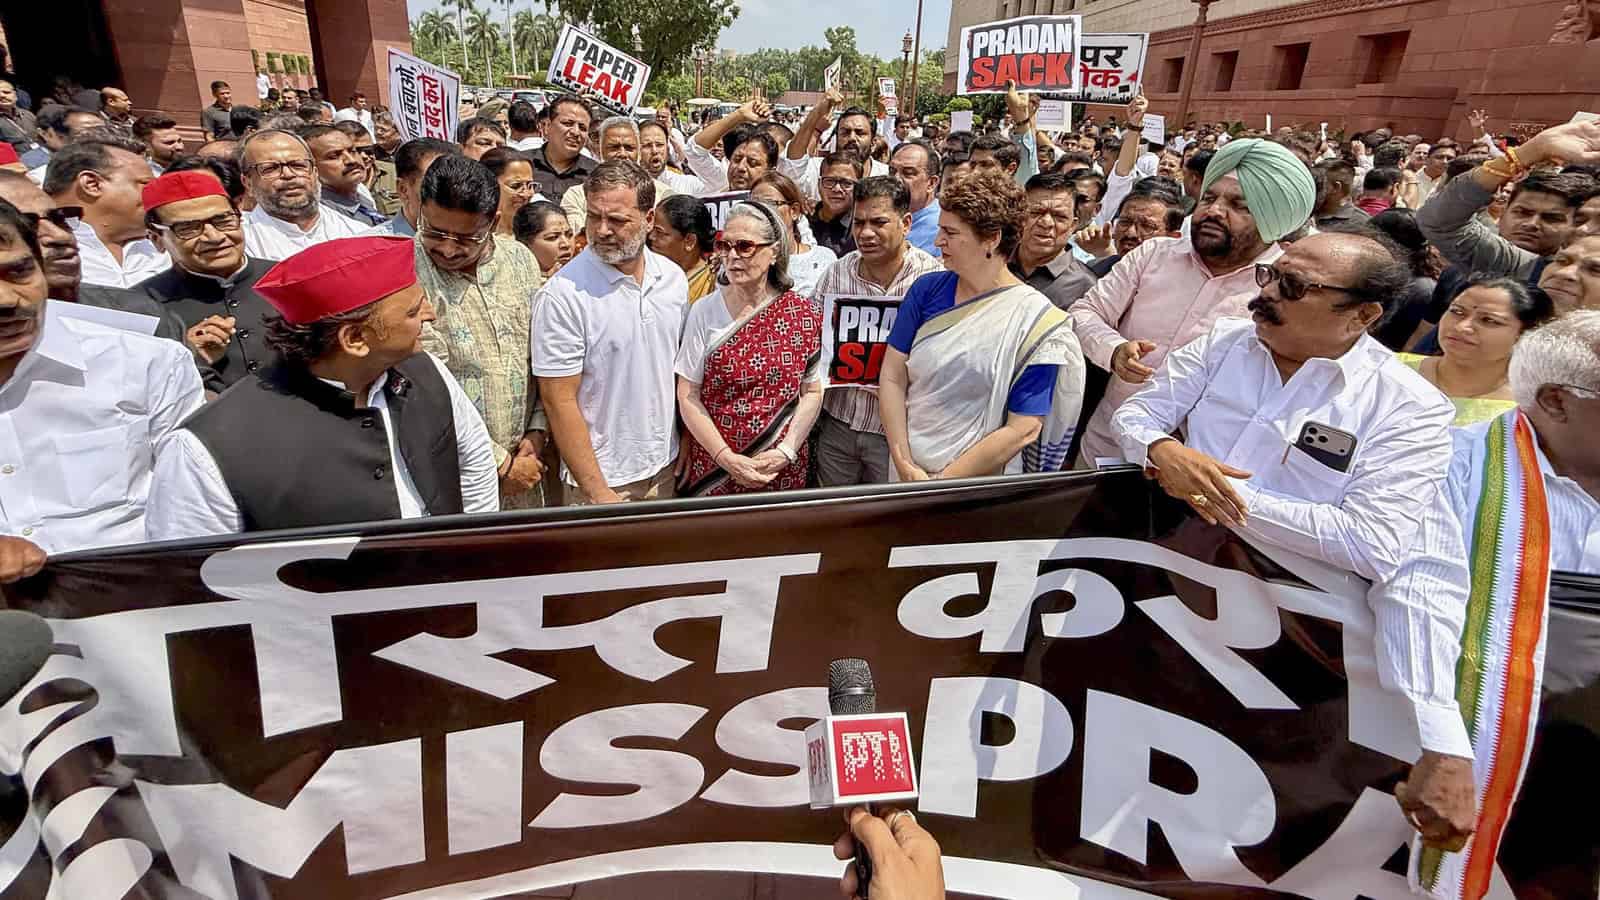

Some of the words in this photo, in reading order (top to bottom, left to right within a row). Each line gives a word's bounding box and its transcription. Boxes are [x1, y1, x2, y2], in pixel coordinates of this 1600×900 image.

[973, 24, 1074, 59] PRADAN
[1081, 46, 1128, 68] पर
[570, 35, 637, 84] PAPER
[972, 53, 1072, 88] SACK
[417, 73, 441, 104] करो
[562, 56, 632, 105] LEAK
[421, 103, 442, 128] बंद
[839, 306, 898, 343] PRA
[841, 730, 905, 783] PTI
